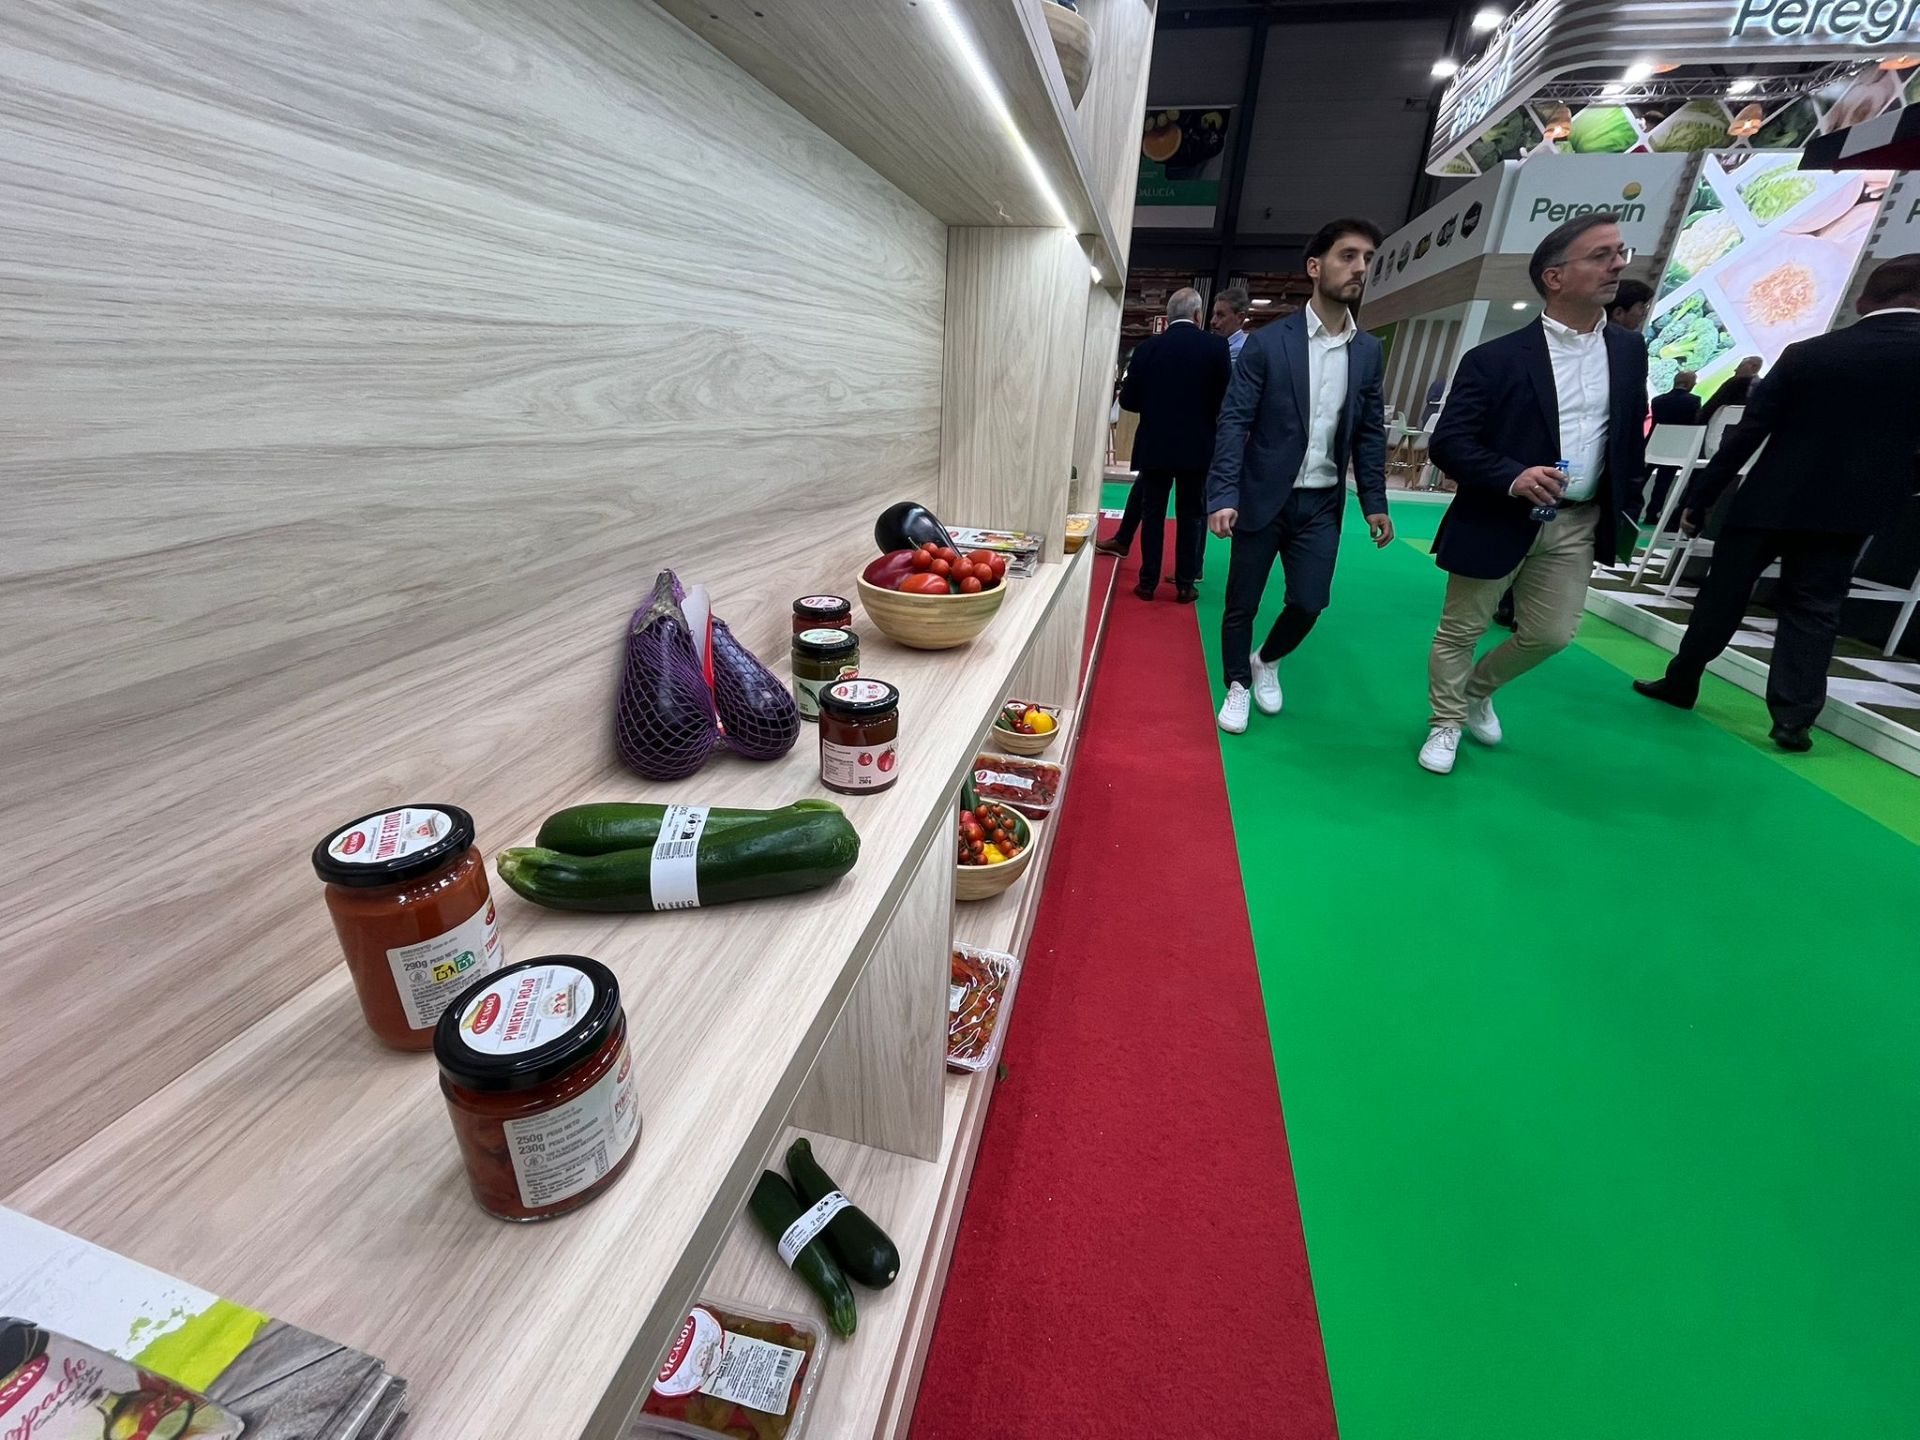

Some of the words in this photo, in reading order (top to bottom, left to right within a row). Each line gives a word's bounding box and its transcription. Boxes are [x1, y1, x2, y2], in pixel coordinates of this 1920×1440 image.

[382, 812, 402, 834] FRITO
[376, 832, 399, 859] TOMATE
[475, 995, 498, 1031] VICASOL
[503, 1001, 529, 1041] PIMIENTO
[517, 978, 536, 999] ROJO
[516, 1133, 544, 1145] 250g
[546, 1127, 563, 1137] PESO
[564, 1119, 580, 1129] NETO
[518, 1144, 546, 1155] 230g
[548, 1137, 565, 1147] PESO
[660, 1321, 694, 1377] VICASOL
